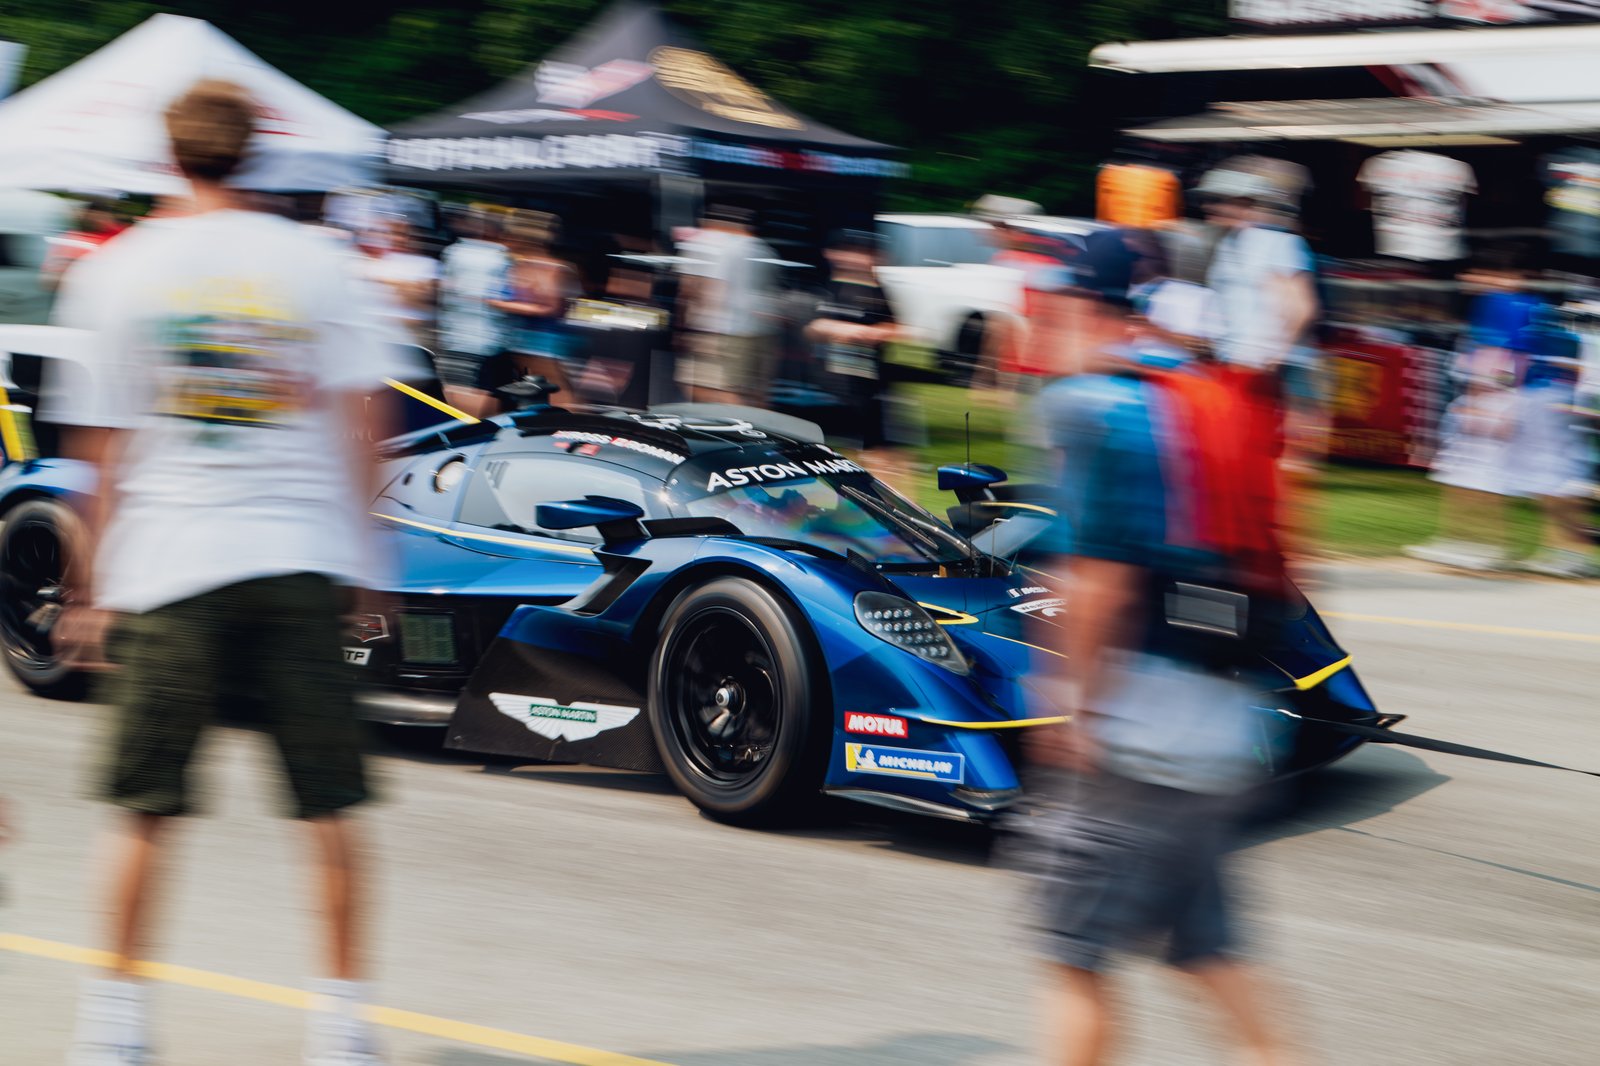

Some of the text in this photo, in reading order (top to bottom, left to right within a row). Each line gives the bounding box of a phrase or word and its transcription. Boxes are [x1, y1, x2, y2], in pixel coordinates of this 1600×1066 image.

[706, 461, 809, 493] ASTON
[343, 650, 365, 661] TP
[531, 705, 596, 722] ASTON MARTIN
[848, 715, 905, 736] MOTUL
[879, 755, 953, 774] MICHELIN
